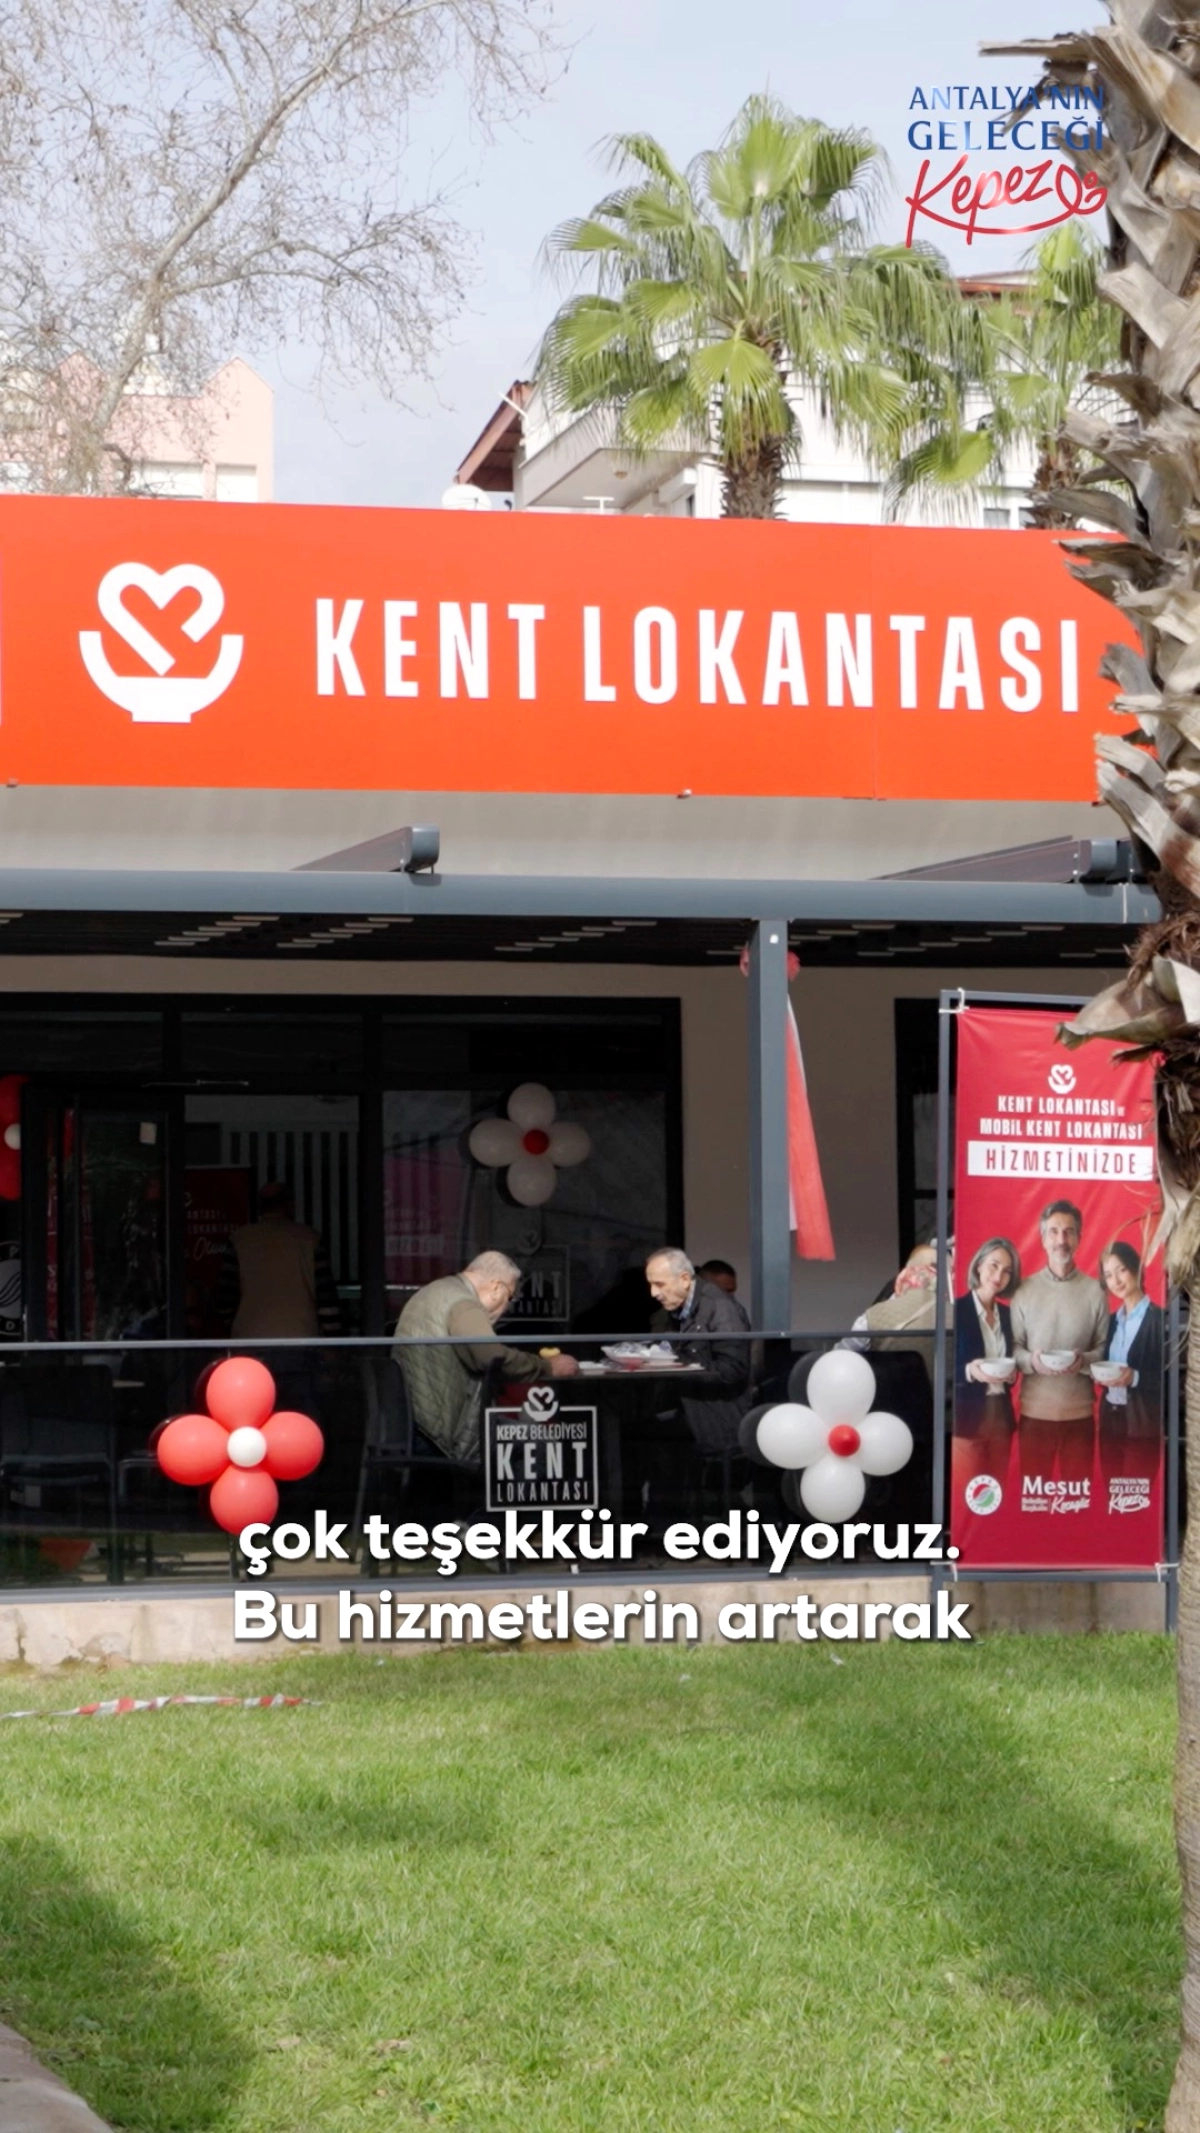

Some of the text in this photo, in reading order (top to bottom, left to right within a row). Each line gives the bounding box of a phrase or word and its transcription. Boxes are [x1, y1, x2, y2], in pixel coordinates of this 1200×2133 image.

[315, 597, 1079, 714] KENT LOKANTASI
[997, 1095, 1033, 1113] KENT
[1038, 1097, 1115, 1116] LOKANTASI
[979, 1118, 1143, 1140] MOBİL KENT LOKANTASI
[986, 1145, 1136, 1174] HİZMETİNİZDE
[496, 1421, 587, 1440] KEPEZ BELEDİYESİ
[496, 1442, 587, 1480] KENT
[496, 1481, 588, 1502] LOKANTASI
[1022, 1475, 1091, 1496] Mesut
